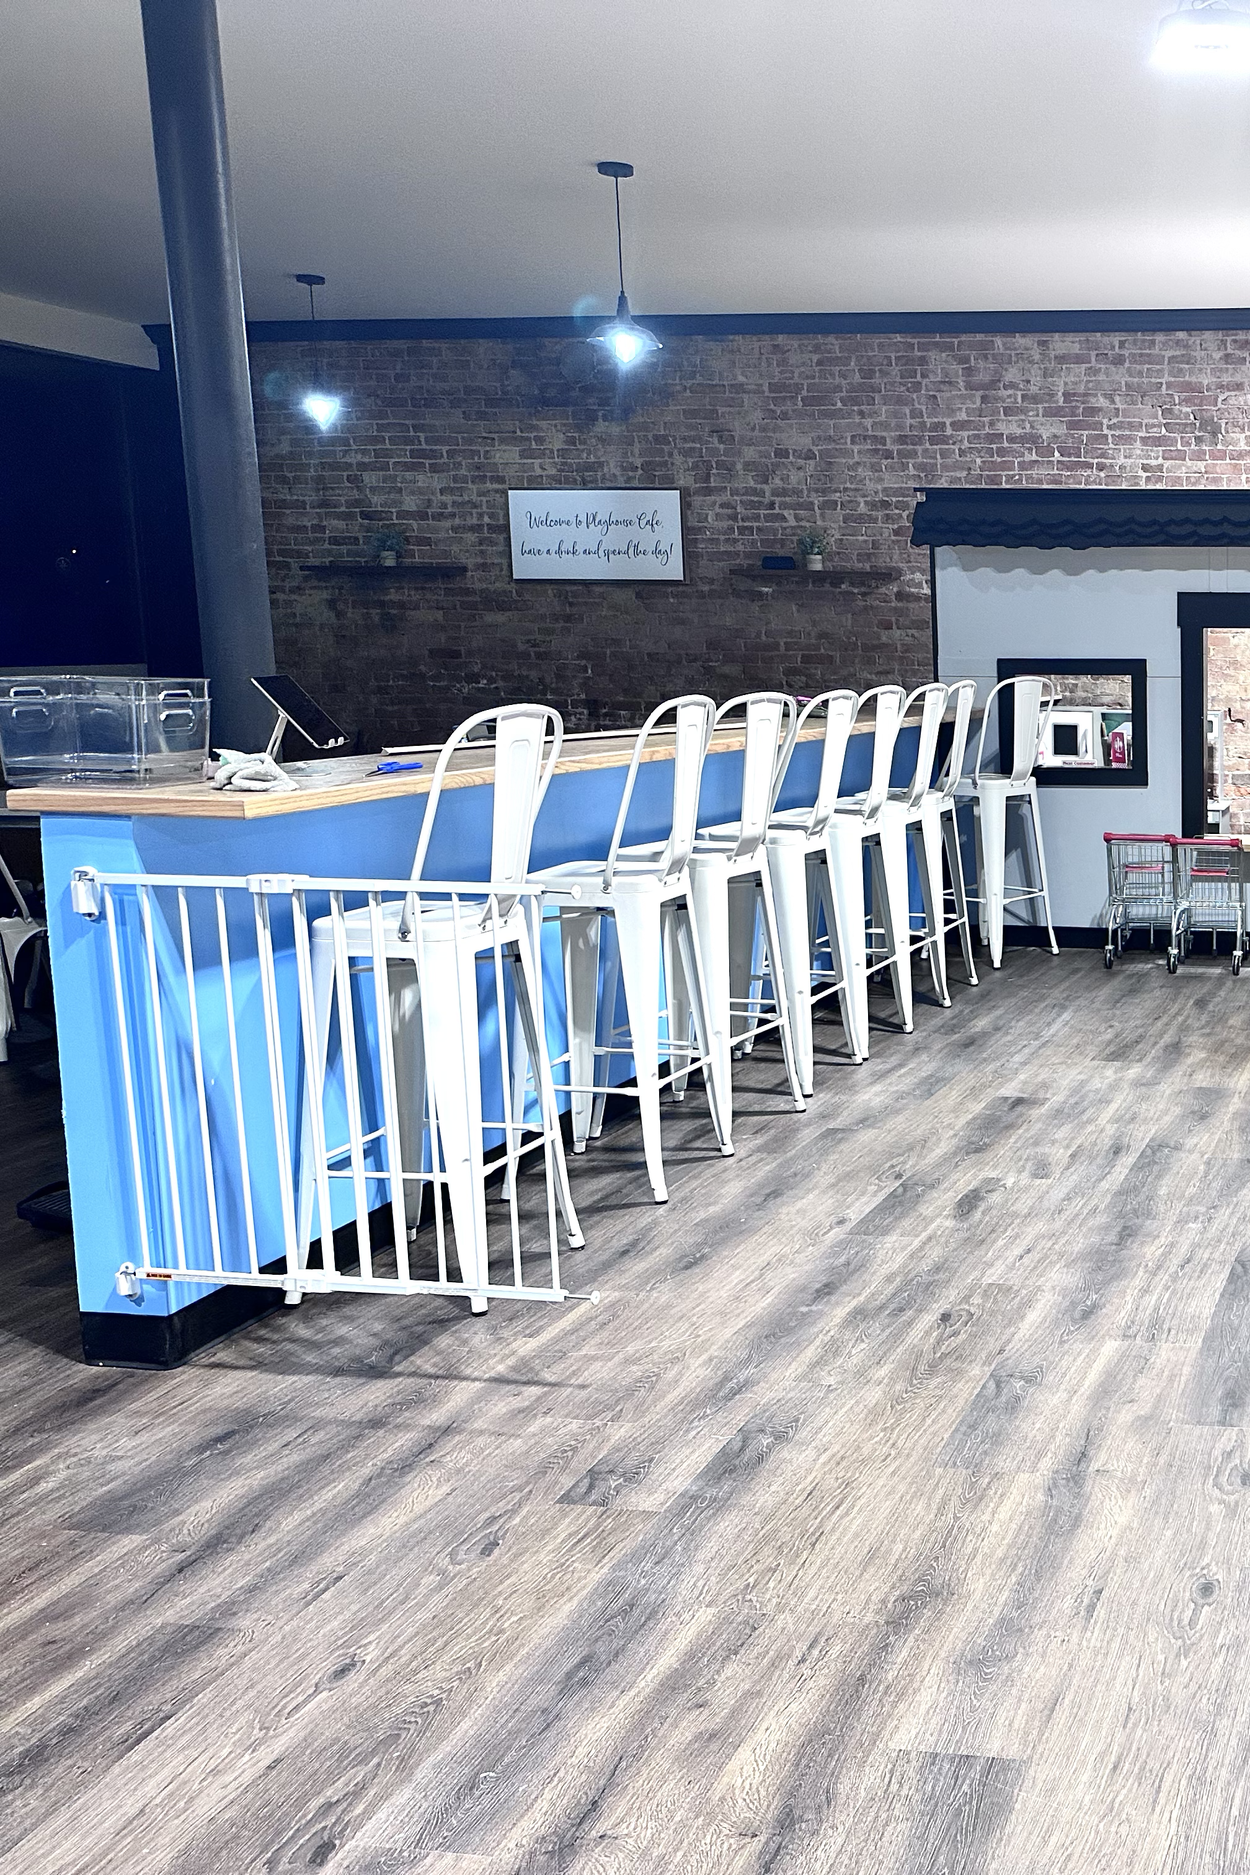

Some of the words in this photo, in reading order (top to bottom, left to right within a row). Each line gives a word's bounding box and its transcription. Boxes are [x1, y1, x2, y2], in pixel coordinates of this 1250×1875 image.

[526, 511, 573, 529] Welcome
[574, 513, 583, 529] to
[585, 511, 636, 536] Playhouse
[520, 540, 543, 557] have
[553, 539, 580, 558] drink
[582, 539, 603, 558] and
[603, 539, 633, 563] spend
[632, 540, 650, 558] the
[651, 540, 674, 566] day!
